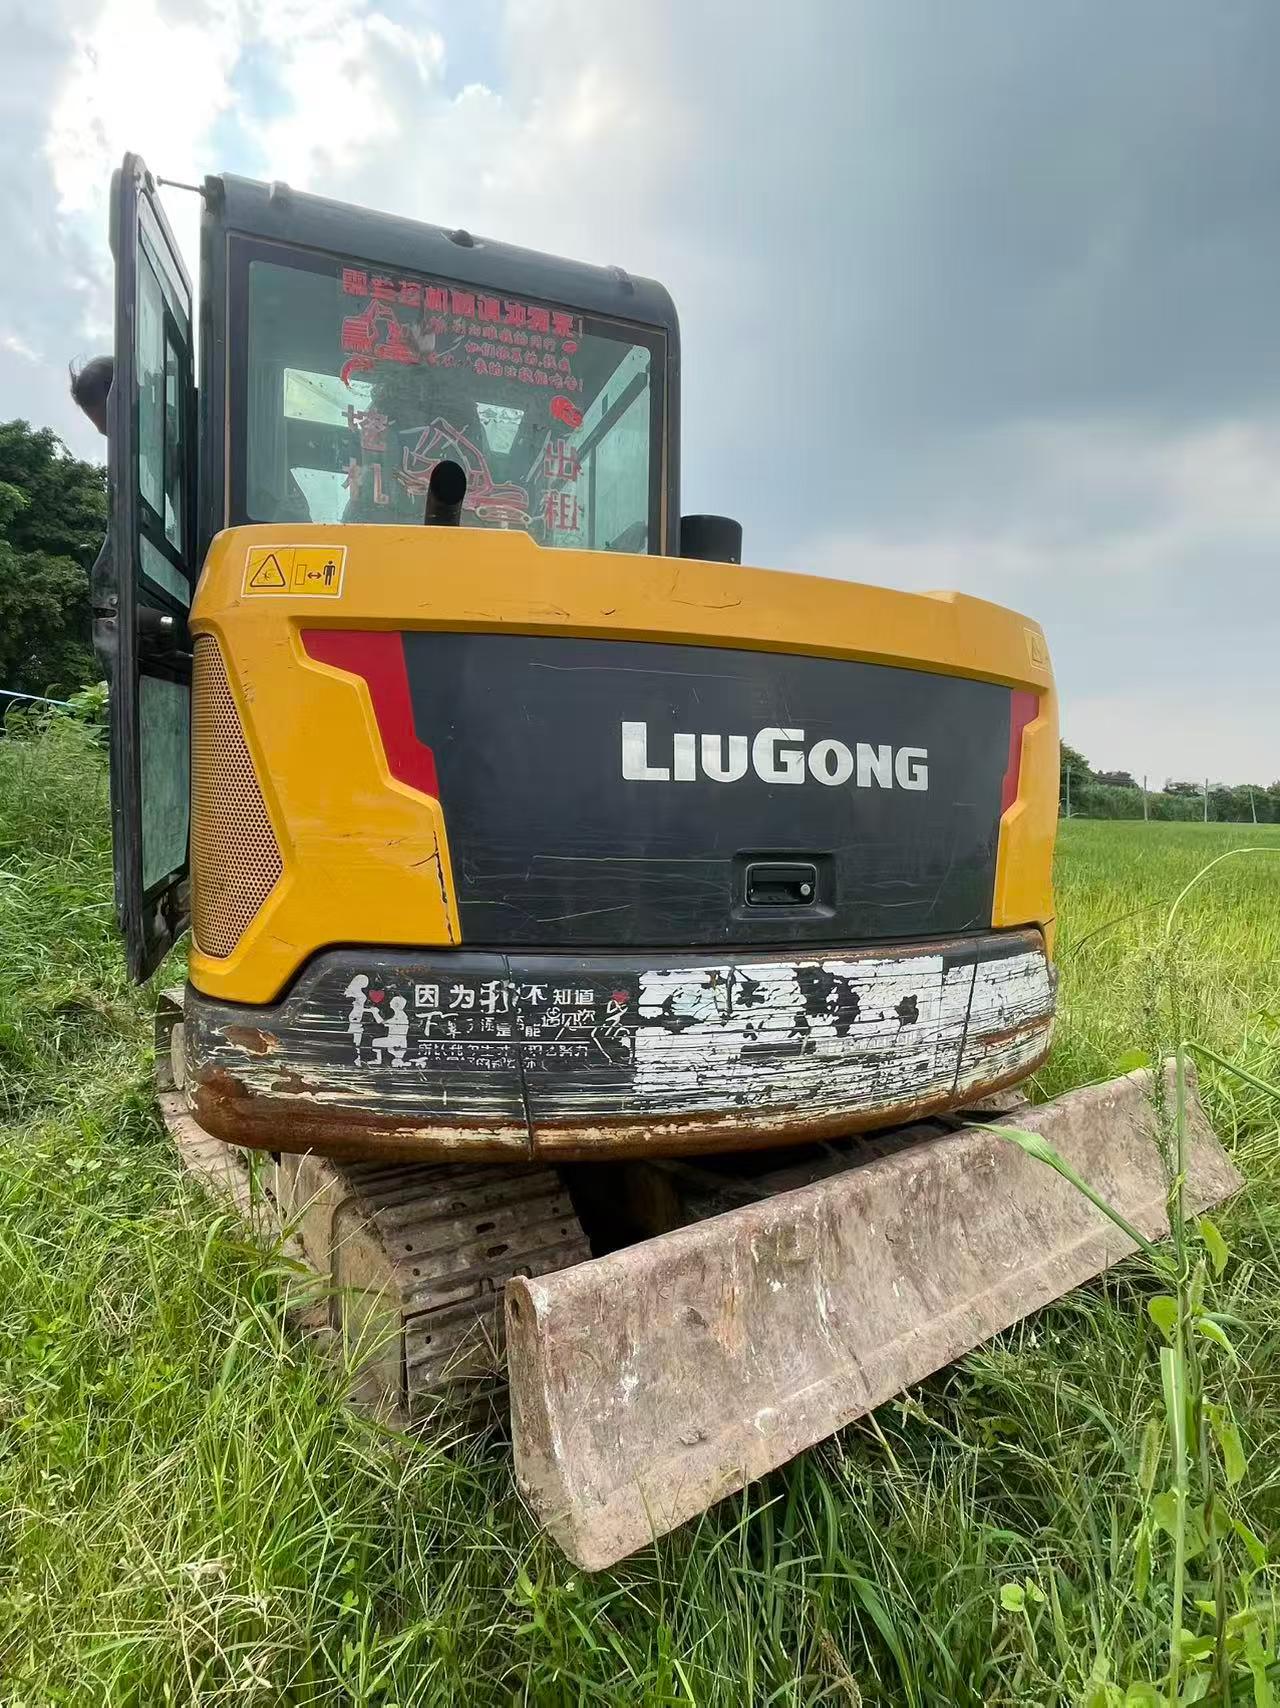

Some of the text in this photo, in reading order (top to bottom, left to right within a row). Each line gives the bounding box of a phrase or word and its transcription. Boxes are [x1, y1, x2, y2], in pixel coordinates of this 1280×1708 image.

[544, 438, 582, 531] 出租
[414, 979, 595, 1014] 因为我不知道
